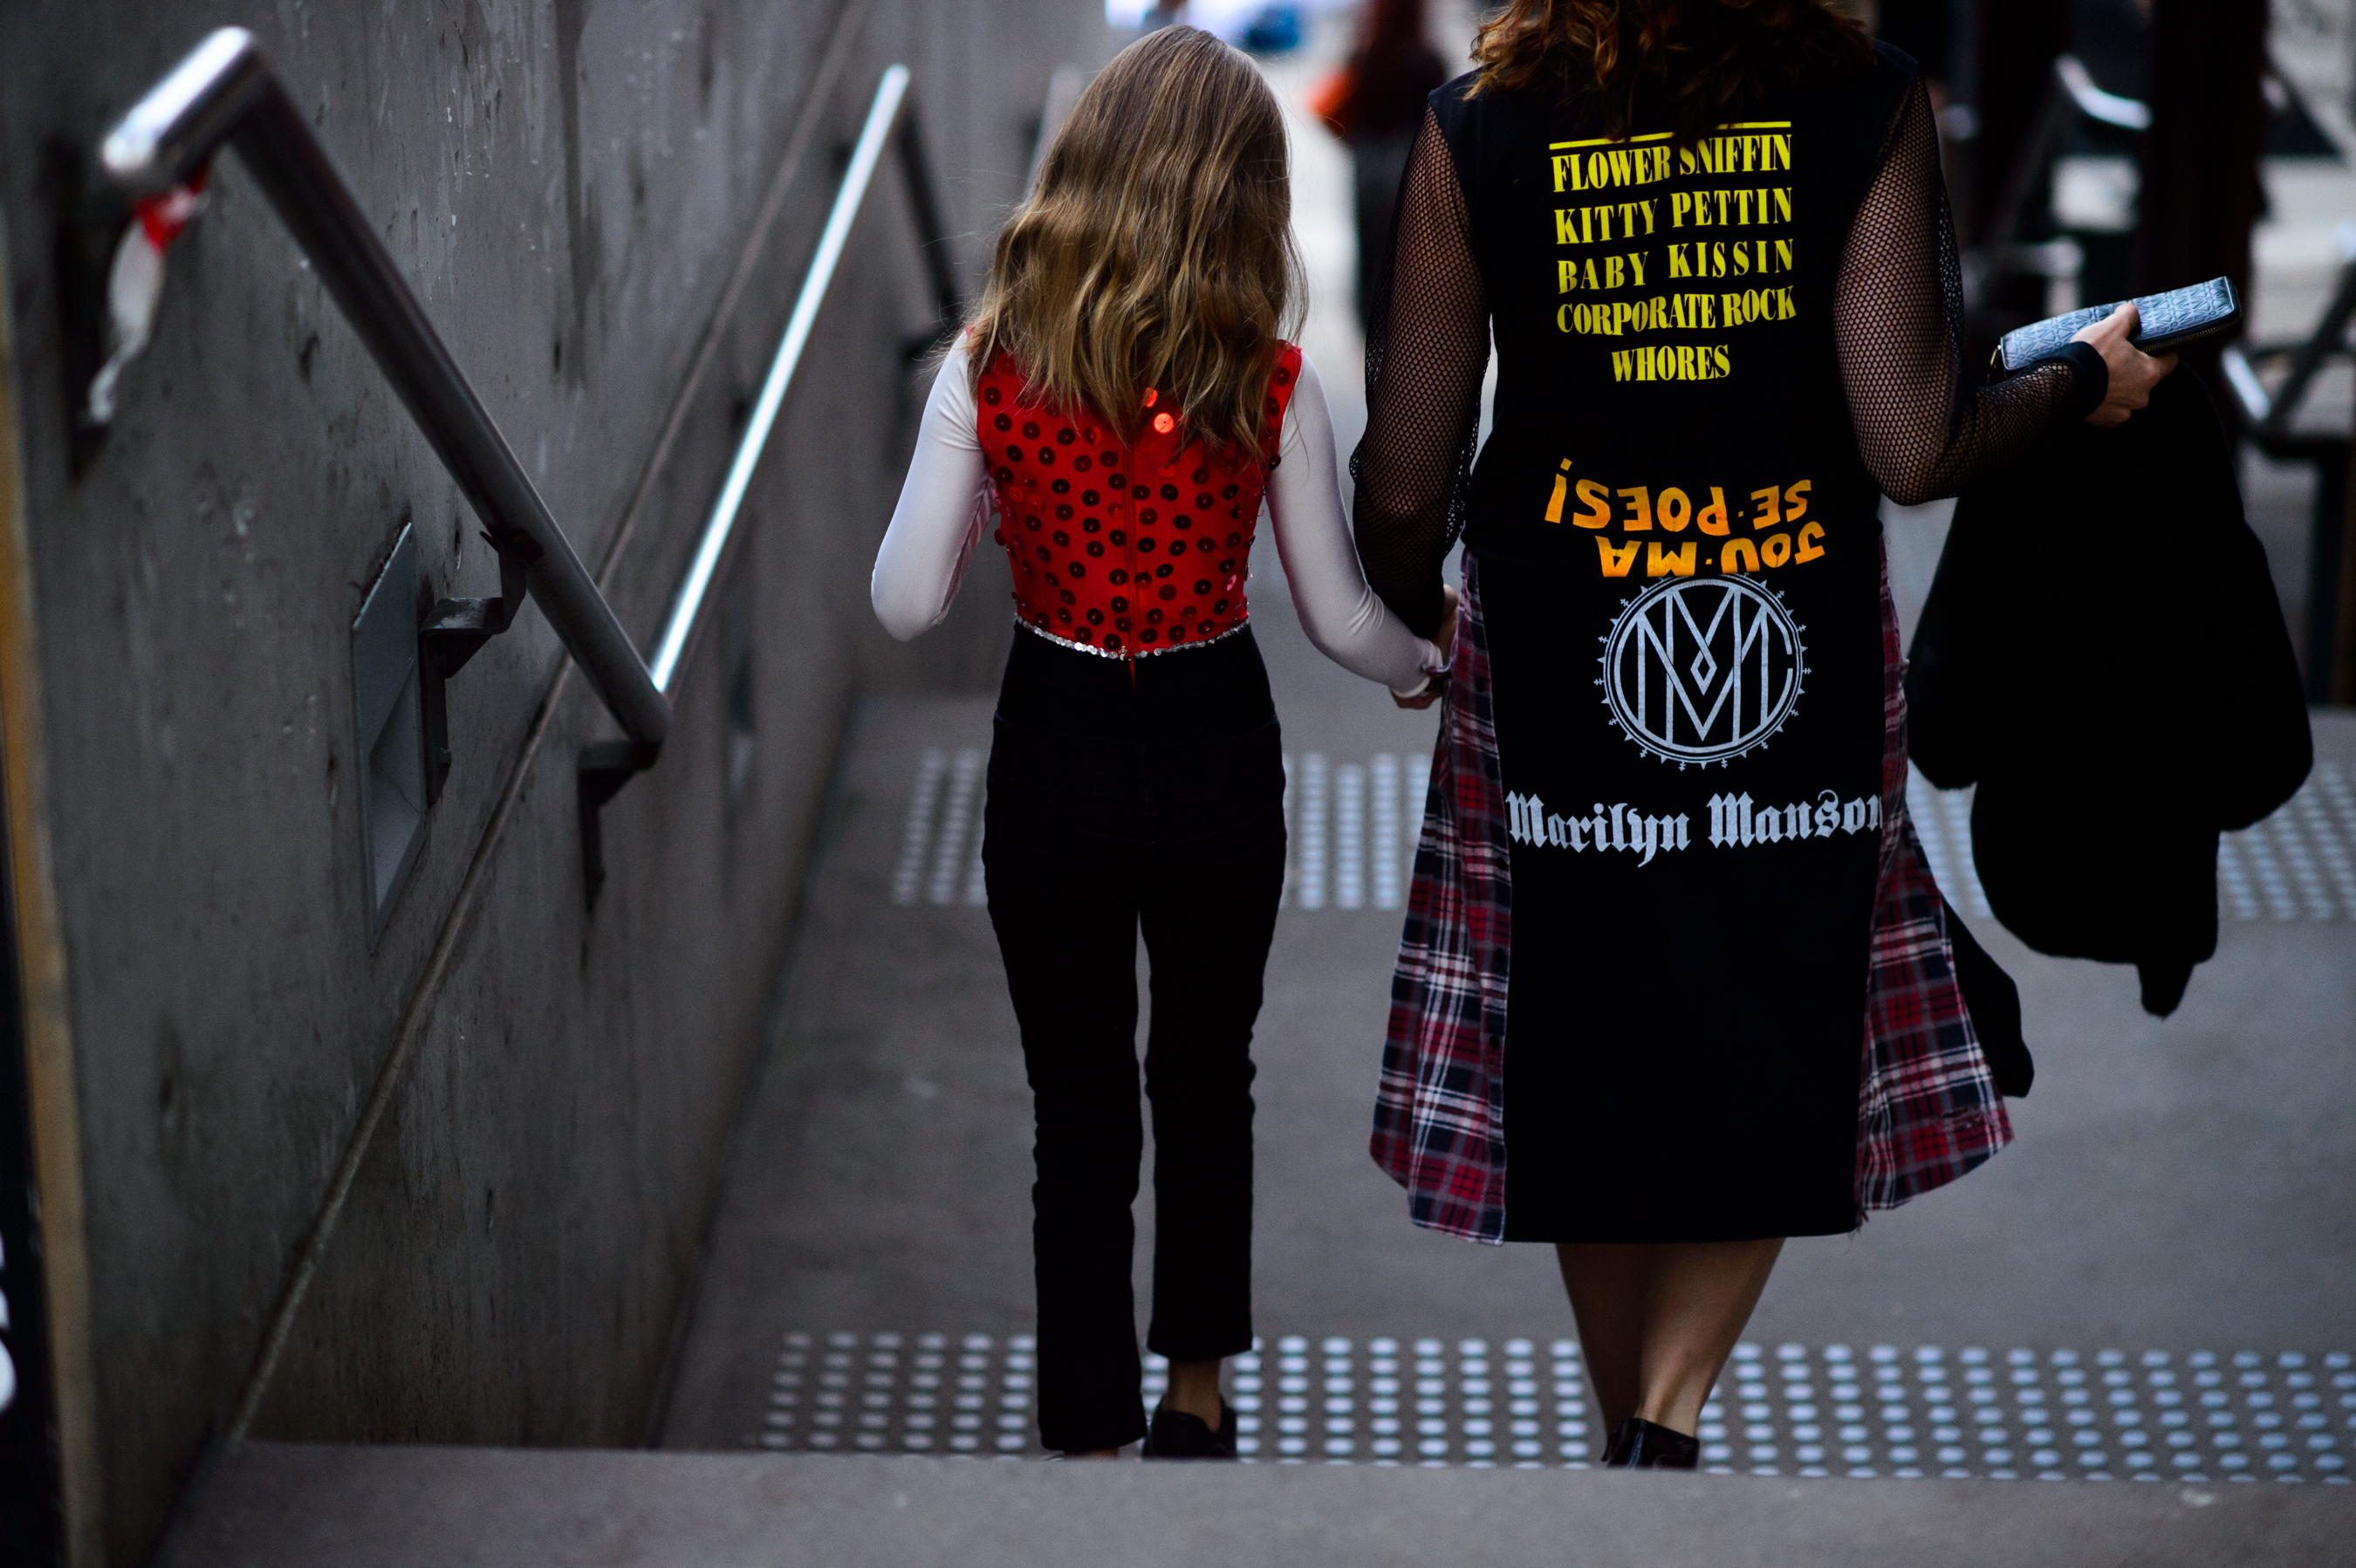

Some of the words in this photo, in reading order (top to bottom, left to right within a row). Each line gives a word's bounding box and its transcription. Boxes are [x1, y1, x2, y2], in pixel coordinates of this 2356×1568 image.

[1551, 146, 1670, 192] FLOWER
[1680, 134, 1791, 175] SNIFFIN
[1554, 199, 1658, 244] KITTY
[1670, 188, 1791, 228] PETTIN
[1558, 251, 1648, 293] BABY
[1668, 239, 1793, 277] KISSIN
[1558, 294, 1716, 335] CORPORATE
[1721, 285, 1796, 327] ROCK
[1612, 345, 1730, 381] WHORES
[1506, 791, 1691, 867] Marilyn
